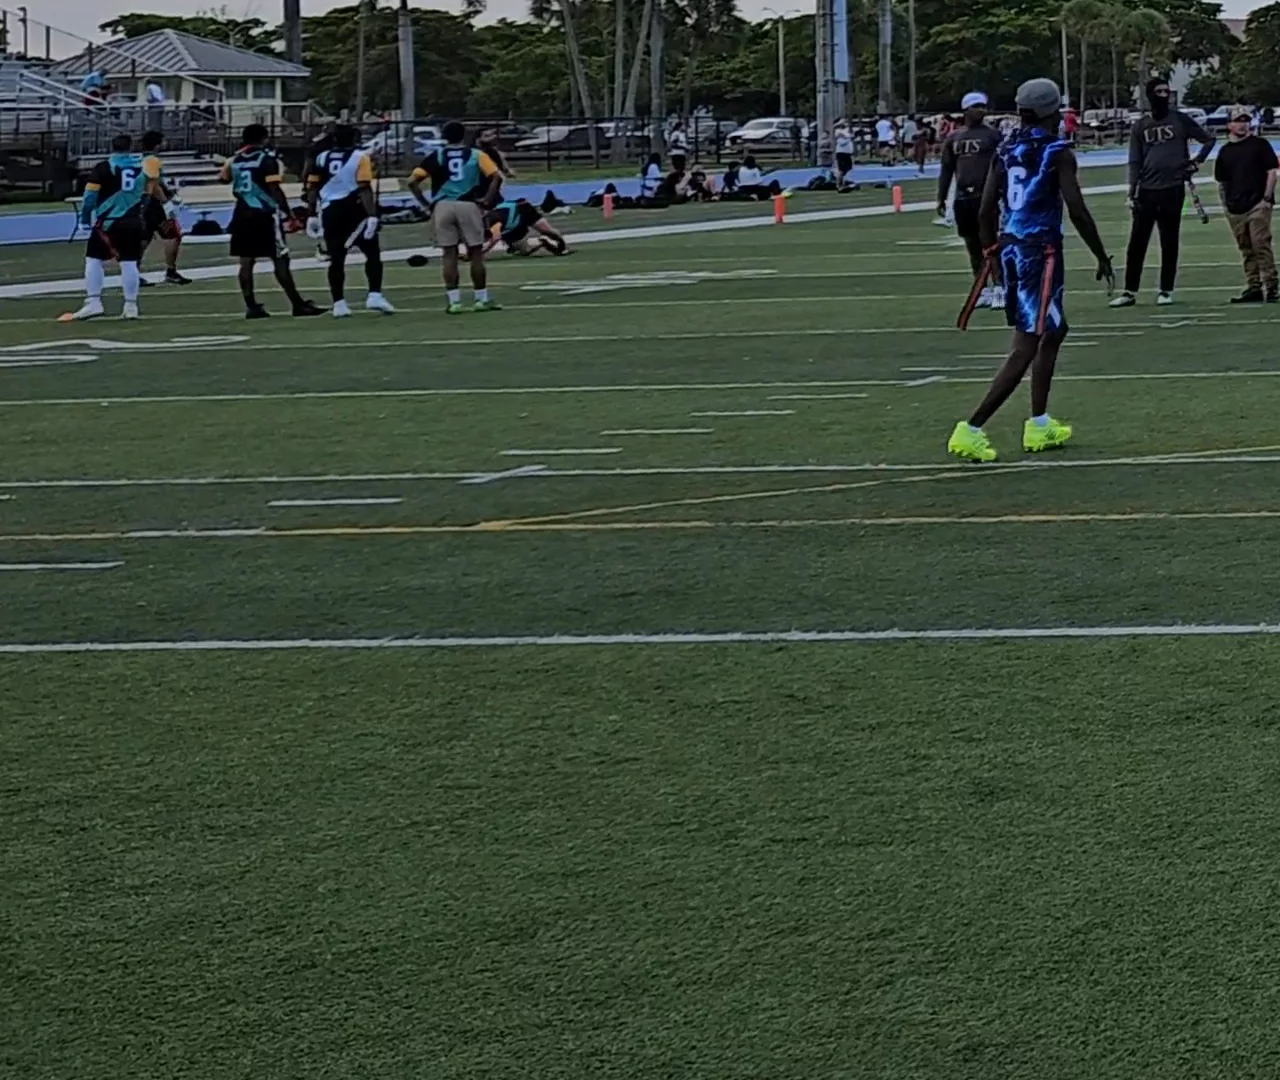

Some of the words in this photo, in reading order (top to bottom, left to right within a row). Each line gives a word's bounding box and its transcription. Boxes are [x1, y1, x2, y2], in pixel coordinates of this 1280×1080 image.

[121, 169, 135, 192] 6
[239, 170, 252, 192] 3
[449, 158, 464, 181] 9
[1007, 166, 1027, 211] 6
